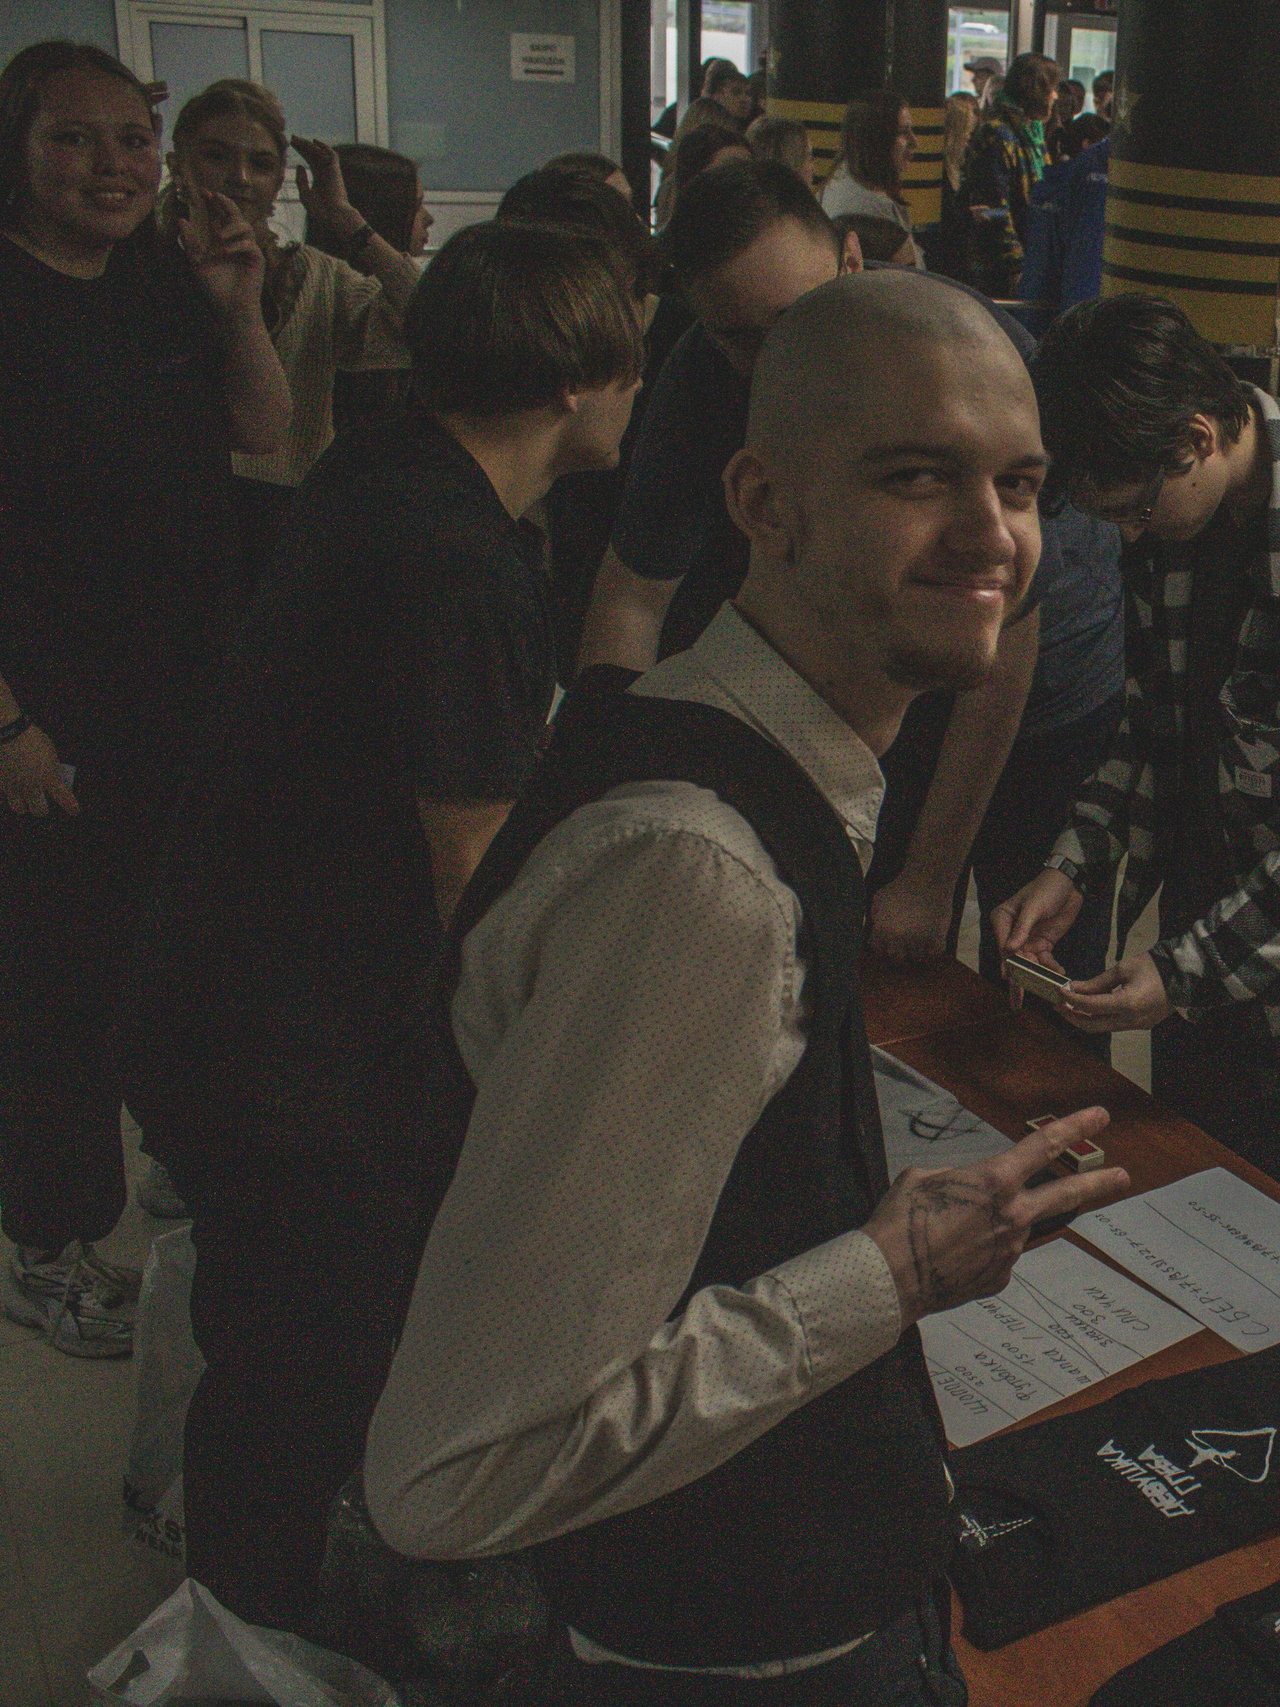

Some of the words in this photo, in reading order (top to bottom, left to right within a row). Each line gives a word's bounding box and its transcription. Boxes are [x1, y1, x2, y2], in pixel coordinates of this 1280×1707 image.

[1073, 1304, 1106, 1325] 300
[1001, 1342, 1036, 1366] 1500
[954, 1366, 984, 1387] 2500
[1097, 1439, 1195, 1518] ДЕВУШКА
